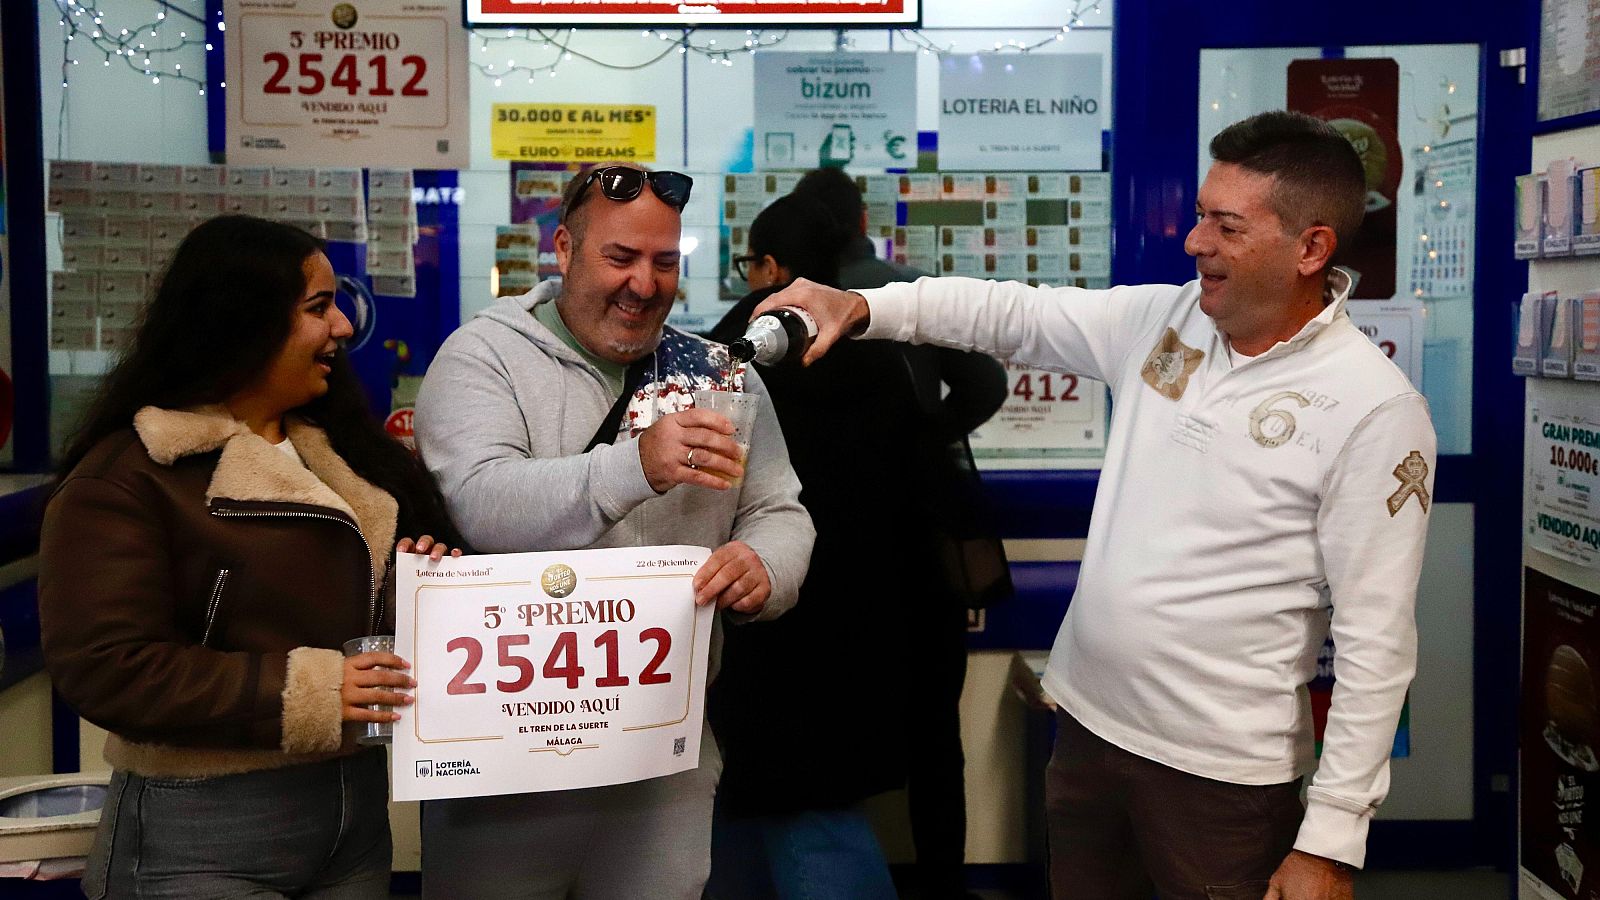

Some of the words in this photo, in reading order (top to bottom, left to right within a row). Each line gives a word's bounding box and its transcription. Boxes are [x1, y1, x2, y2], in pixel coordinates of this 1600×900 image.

[314, 31, 400, 50] PREMIO
[263, 52, 428, 97] 25412
[801, 77, 871, 98] bizum
[302, 102, 355, 113] VENDIDO
[943, 98, 1020, 115] LOTERIA
[1025, 98, 1046, 115] EL
[1051, 94, 1098, 115] NIÑO
[498, 109, 563, 123] 30.000
[581, 109, 604, 123] AL
[520, 146, 559, 157] EURO
[574, 147, 636, 158] DREAMS
[1008, 373, 1080, 402] 412
[1543, 421, 1570, 442] GRAN
[1550, 445, 1599, 476] 10.000€
[1537, 512, 1581, 540] VENDIDO
[416, 568, 443, 578] Lotería
[445, 569, 455, 578] de
[636, 560, 646, 568] 22
[647, 559, 656, 567] de
[657, 558, 698, 567] Diciembre
[484, 605, 506, 629] 5º
[517, 598, 635, 627] PREMIO
[446, 627, 672, 695] 25412
[502, 699, 575, 717] VENDIDO
[580, 694, 620, 714] AQUÍ
[518, 725, 528, 733] EL
[529, 724, 552, 733] TREN
[554, 723, 564, 732] DE
[566, 723, 576, 731] LA
[578, 721, 609, 731] SUERTE
[546, 736, 583, 746] MÁLAGA
[435, 760, 472, 769] LOTERÍA
[435, 767, 481, 777] NACIONAL
